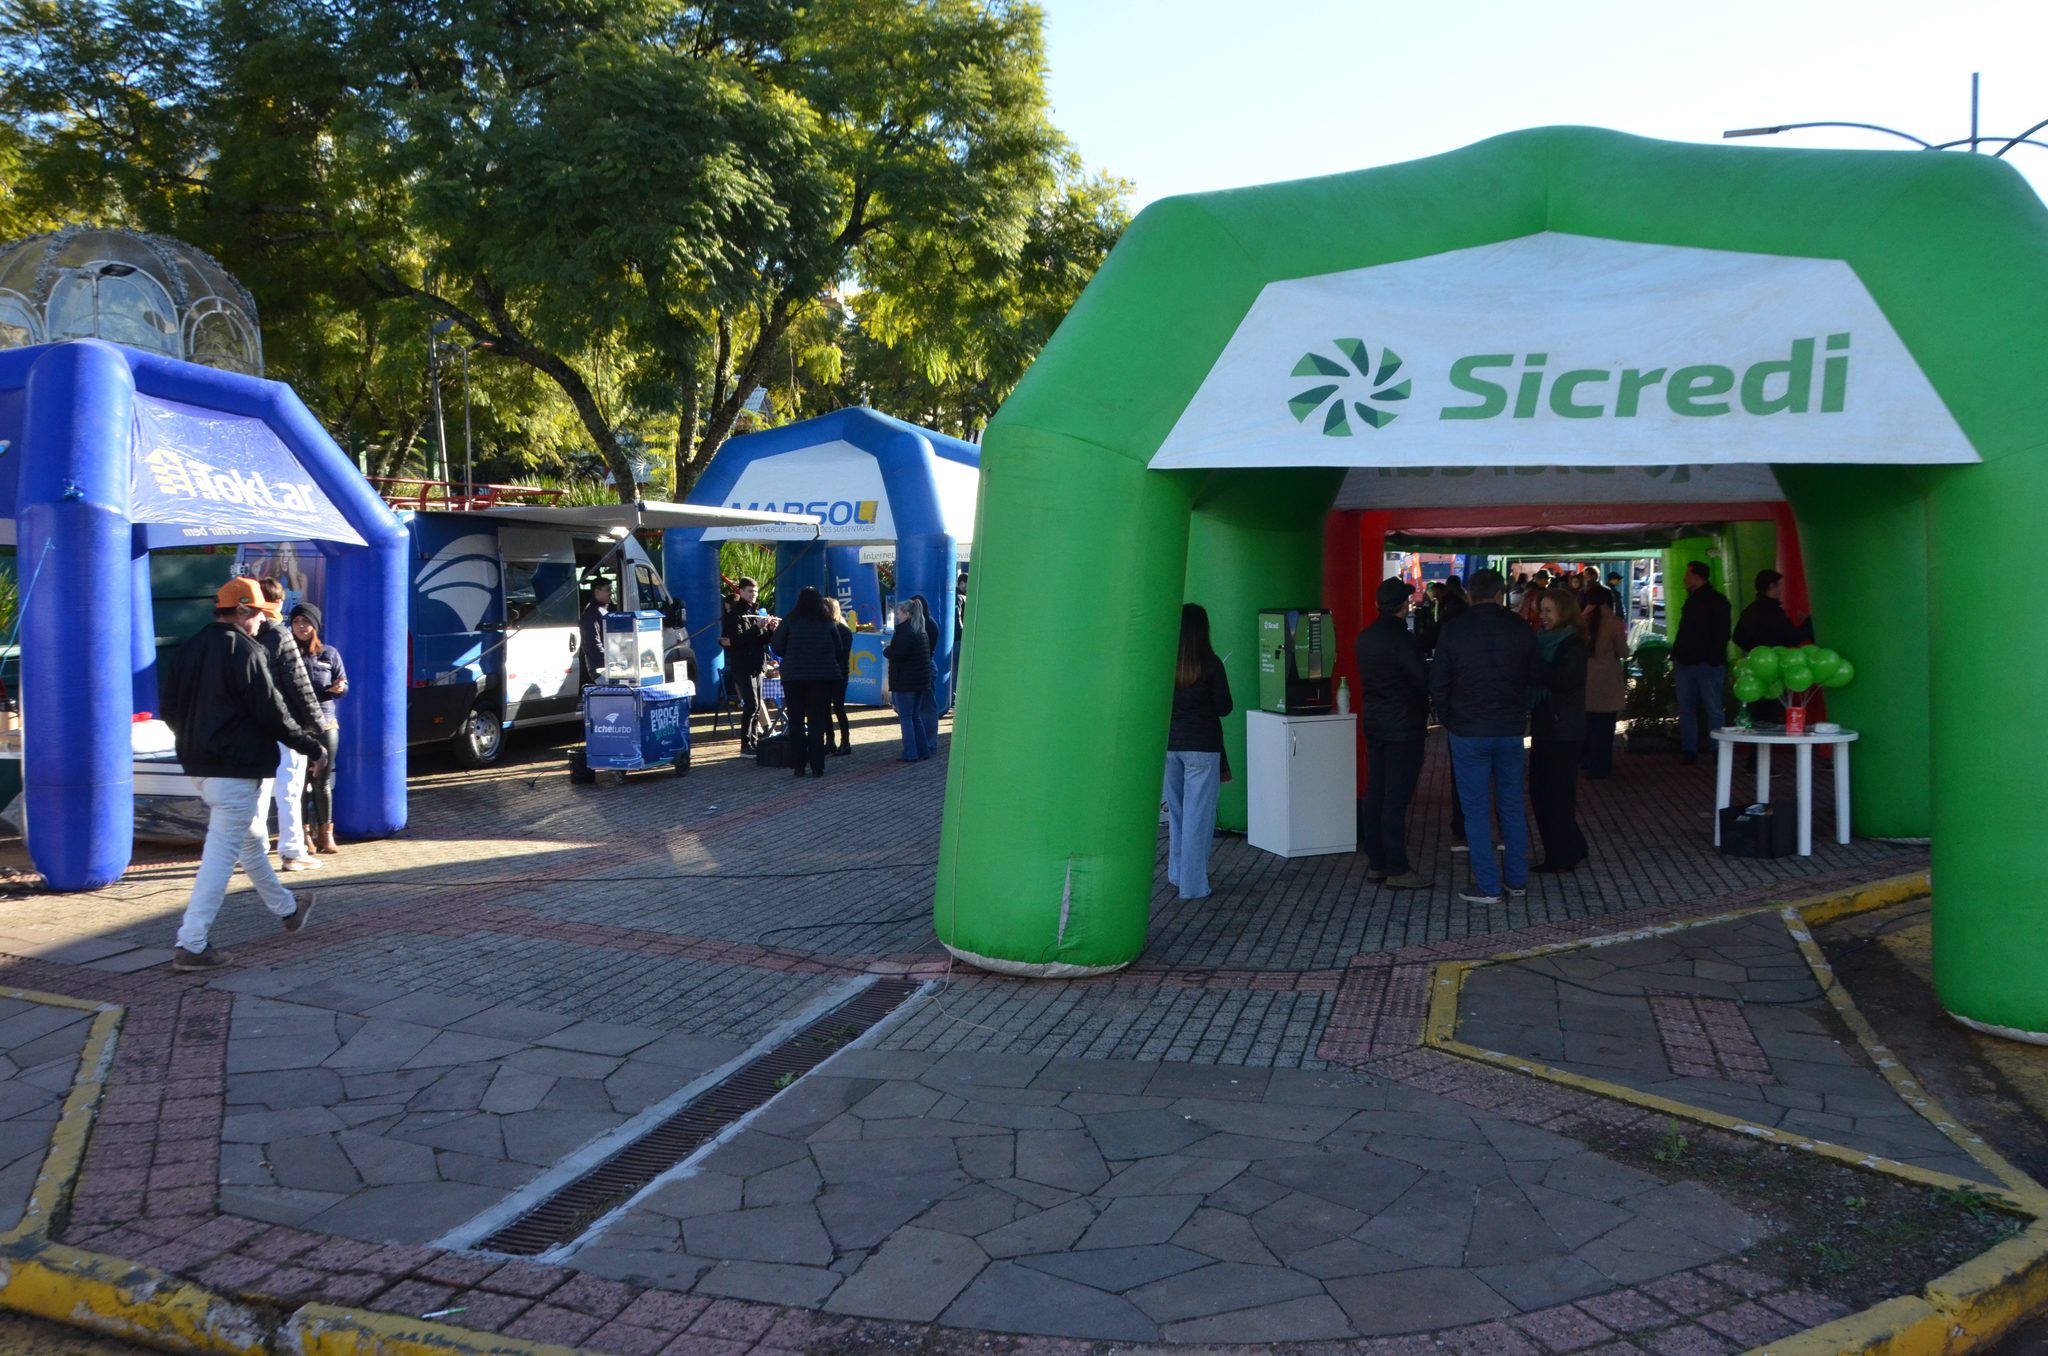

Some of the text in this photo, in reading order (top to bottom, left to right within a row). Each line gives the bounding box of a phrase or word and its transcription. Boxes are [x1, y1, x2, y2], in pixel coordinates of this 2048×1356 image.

[1439, 332, 1850, 420] Sicredi
[186, 459, 316, 512] TokLar
[863, 552, 895, 560] Internet
[650, 705, 679, 721] PIPOCA
